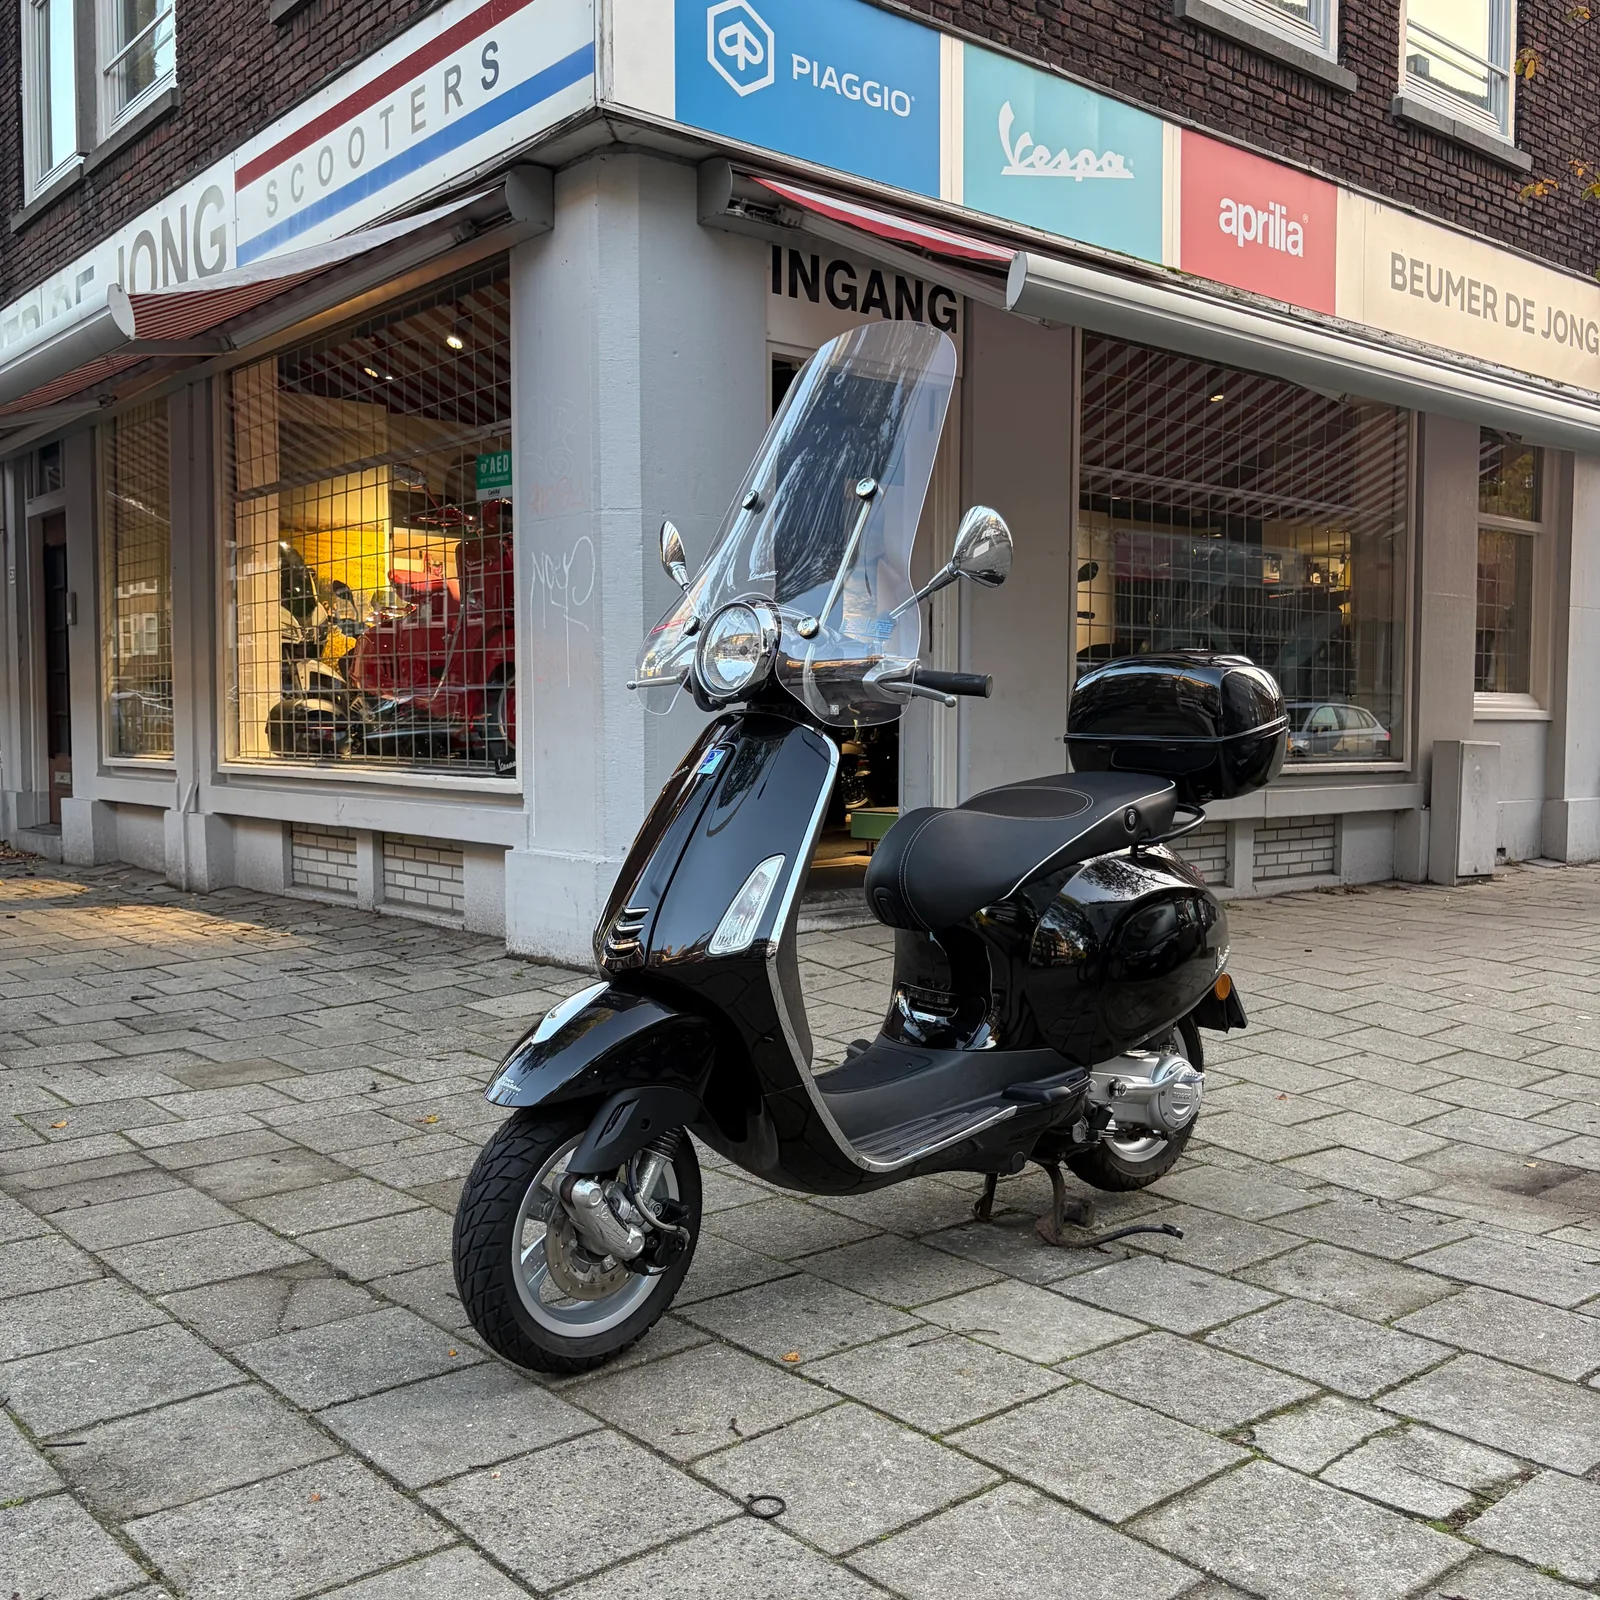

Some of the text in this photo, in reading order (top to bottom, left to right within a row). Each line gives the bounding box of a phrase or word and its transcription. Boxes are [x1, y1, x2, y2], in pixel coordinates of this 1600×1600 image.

[791, 53, 911, 118] PIAGGIO
[267, 41, 500, 218] SCOOTERS
[998, 101, 1134, 182] Vespa
[1219, 197, 1304, 258] aprilia
[771, 244, 958, 335] INGANG
[1390, 251, 1600, 356] BEUMER DE JONG
[489, 454, 509, 474] AED
